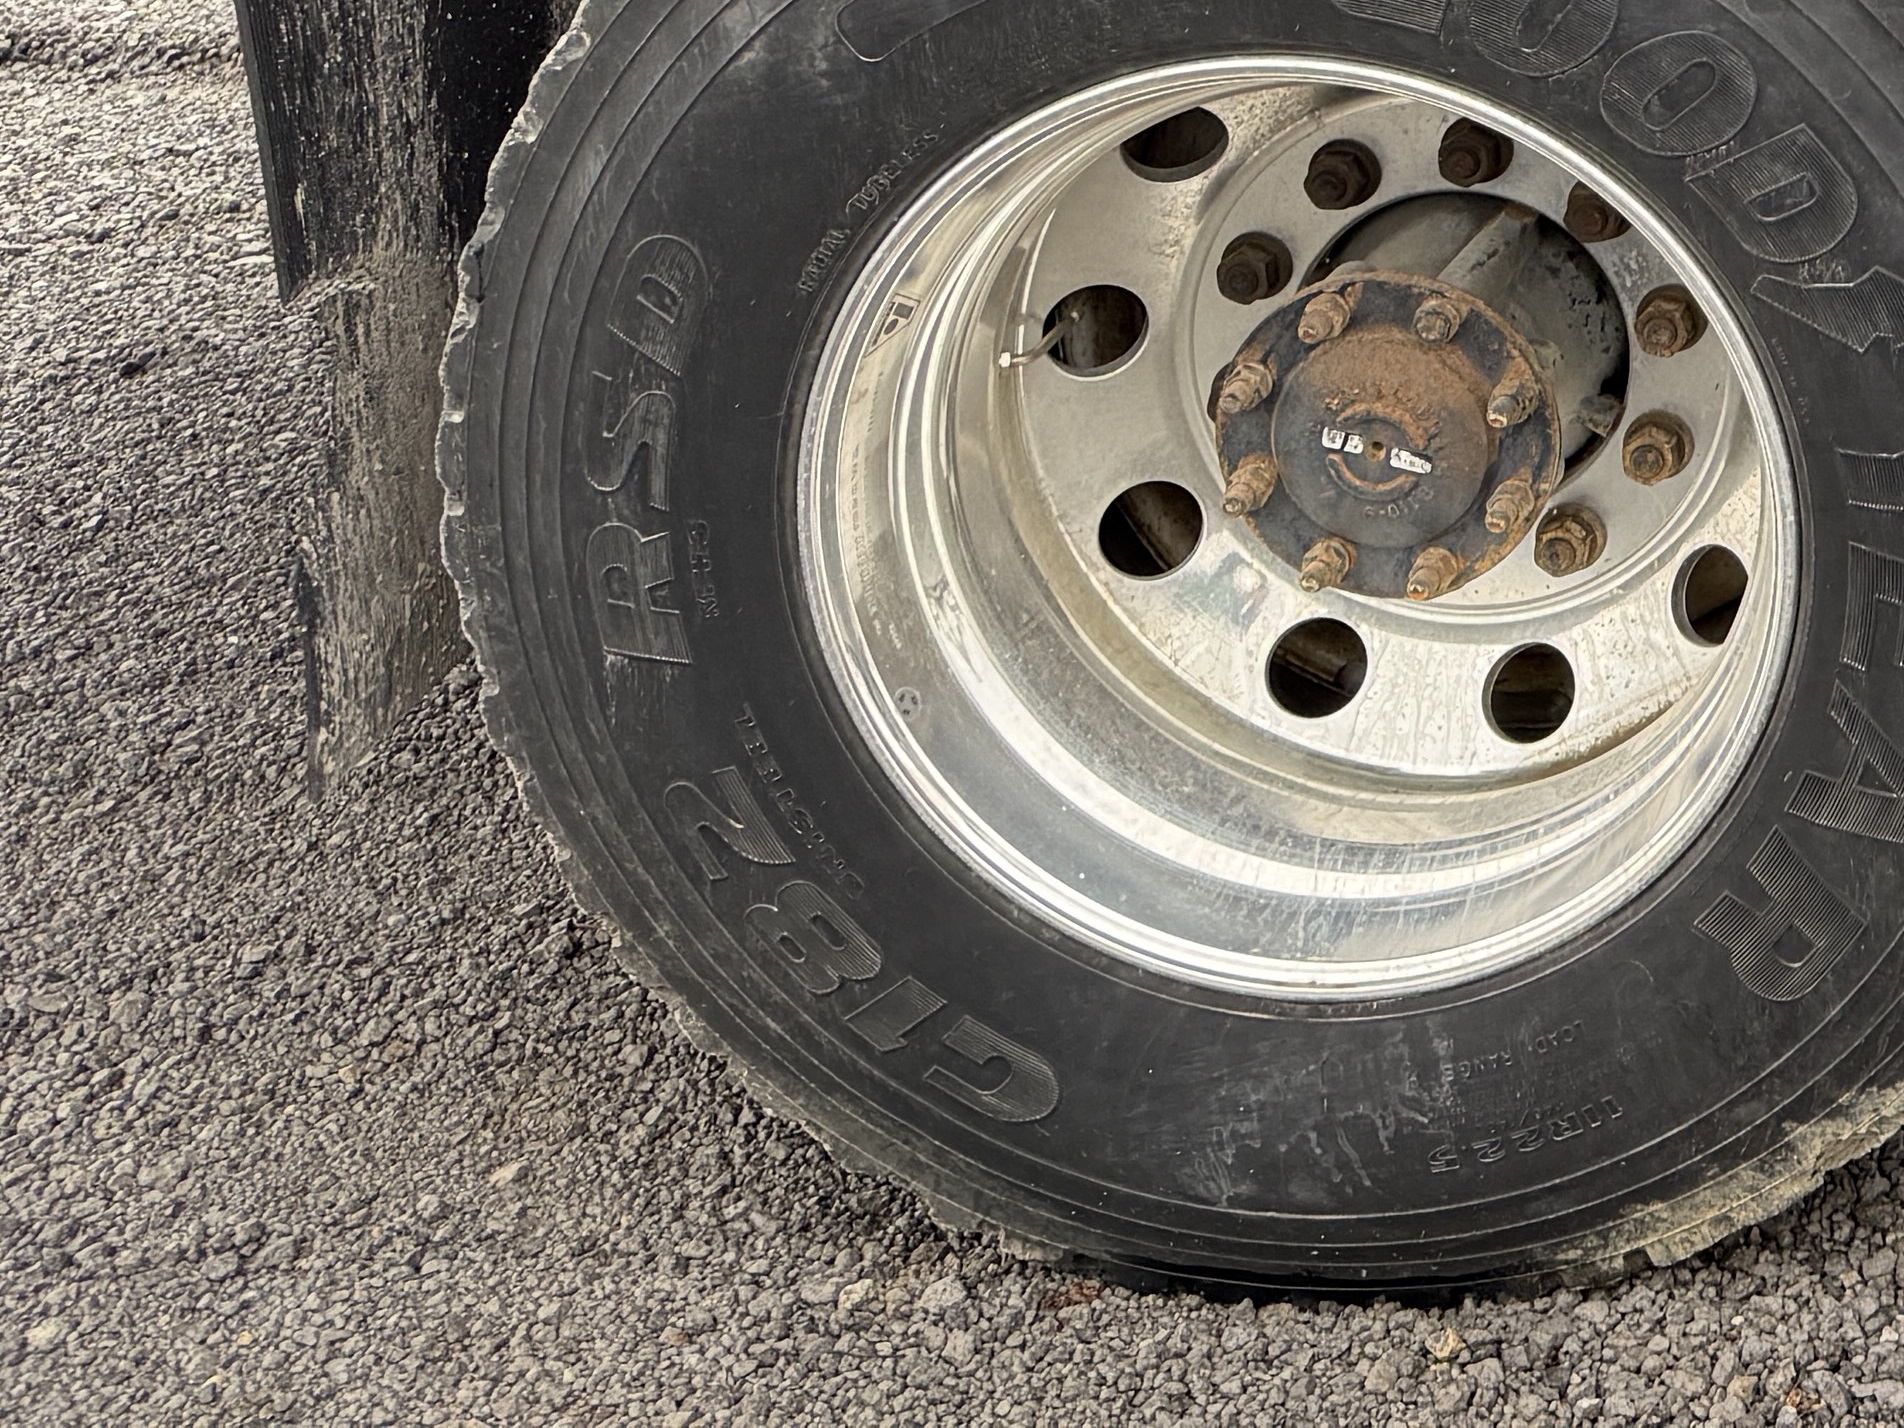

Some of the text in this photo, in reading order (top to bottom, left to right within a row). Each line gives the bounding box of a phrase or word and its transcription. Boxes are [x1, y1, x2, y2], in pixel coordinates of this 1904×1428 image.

[852, 131, 939, 210] TUBELESS
[585, 234, 1061, 1128] G182 RSD
[734, 702, 865, 900] UNISTEEL
[1441, 1051, 1512, 1081] RANGE
[1535, 1020, 1583, 1053] LOAD
[1428, 1095, 1623, 1173] 11R22.5
